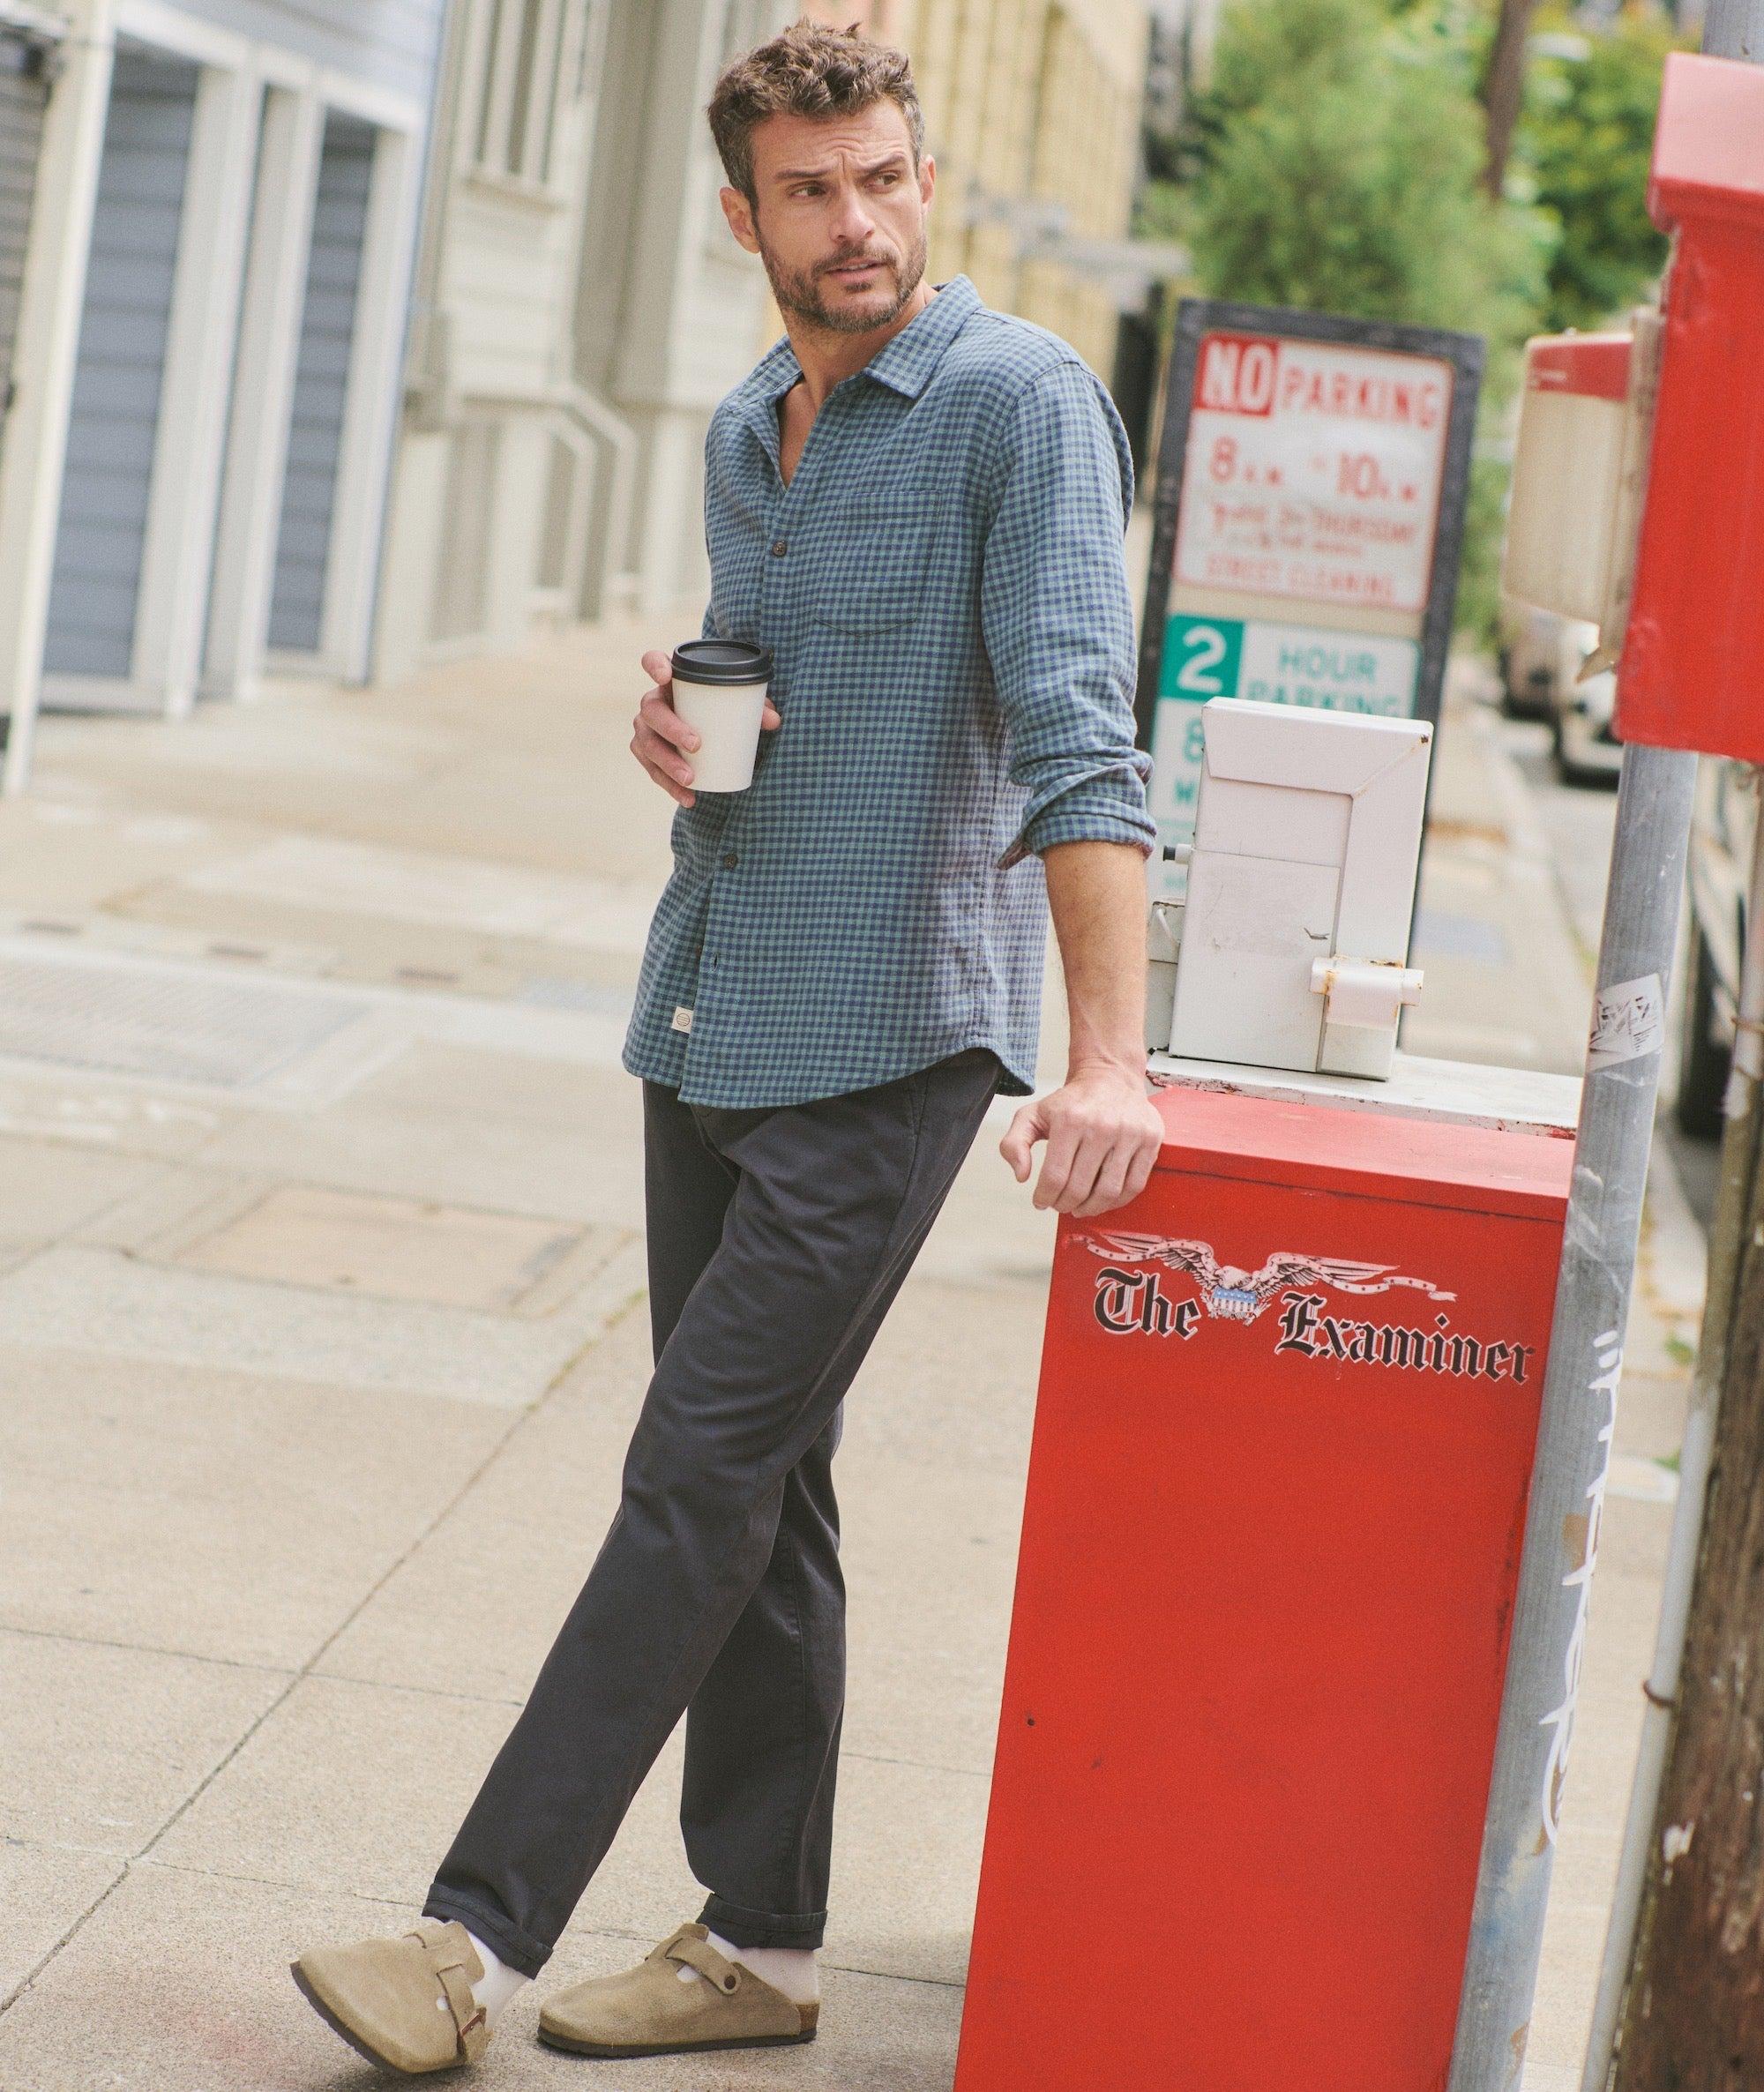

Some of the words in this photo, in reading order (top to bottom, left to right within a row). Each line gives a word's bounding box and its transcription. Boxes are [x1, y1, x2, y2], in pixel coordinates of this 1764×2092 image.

[1203, 339, 1275, 412] NO
[1283, 365, 1440, 430] PARKING
[1209, 437, 1239, 483] 8
[1334, 450, 1380, 500] 10
[1177, 625, 1227, 694] 2
[1279, 645, 1378, 684] HOUR
[1248, 680, 1401, 718] PARKING
[1094, 1266, 1203, 1341] The
[1274, 1290, 1538, 1385] Examiner
